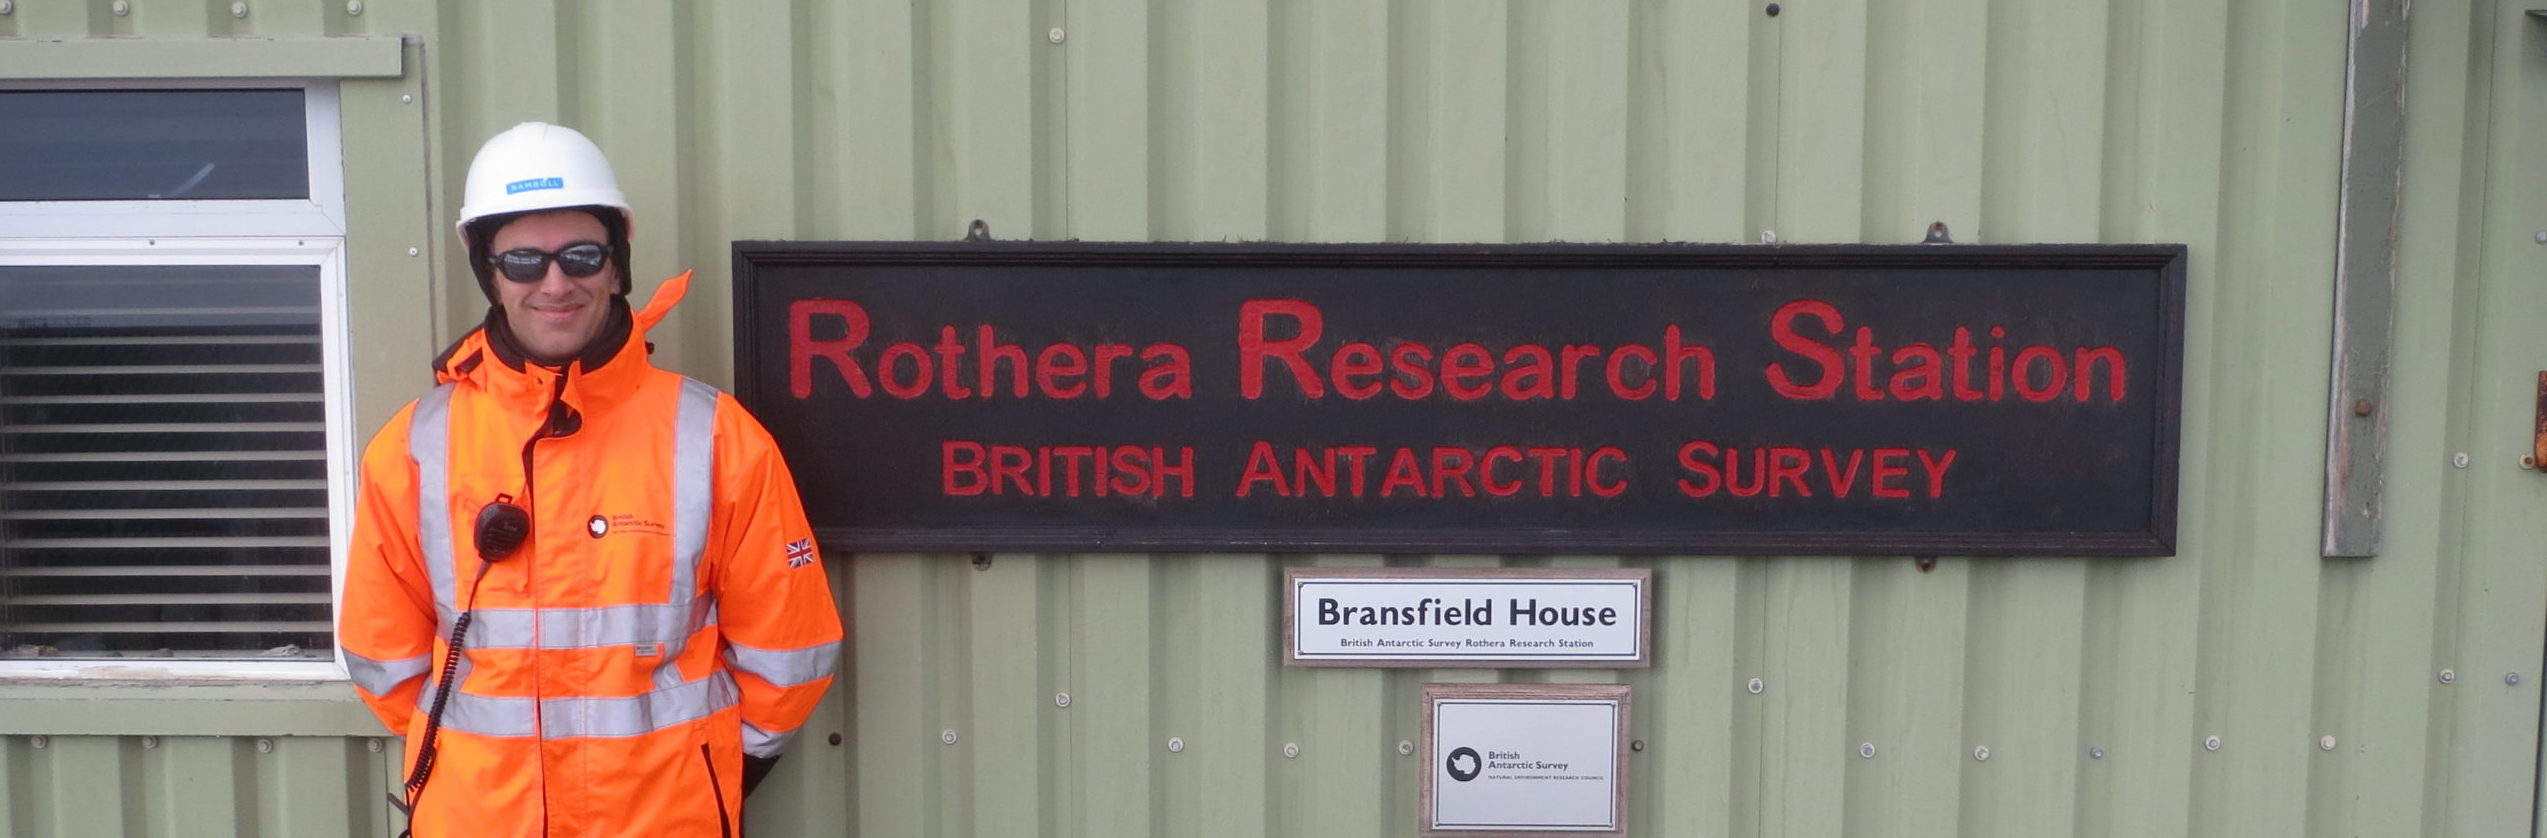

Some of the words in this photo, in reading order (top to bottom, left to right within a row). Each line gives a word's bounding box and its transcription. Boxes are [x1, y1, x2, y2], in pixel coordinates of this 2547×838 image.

[788, 298, 1193, 402] Rothera
[1238, 298, 1717, 402] Research
[1765, 299, 2127, 403] Station
[942, 439, 1195, 499] BRITISH
[1236, 439, 1629, 499] ANTARCTIC
[1678, 439, 1957, 499] SURVEY
[1318, 598, 1492, 626] Bransfield
[1509, 598, 1617, 626] House
[1340, 638, 1373, 647] British
[1377, 638, 1425, 647] Antarctic
[1428, 638, 1462, 649] Survey
[1465, 638, 1505, 648] Rothera
[1509, 638, 1555, 648] Research
[1558, 638, 1594, 648] Station
[1488, 751, 1520, 760] British
[1488, 760, 1534, 770] Antarctic
[1535, 760, 1569, 771] Survey
